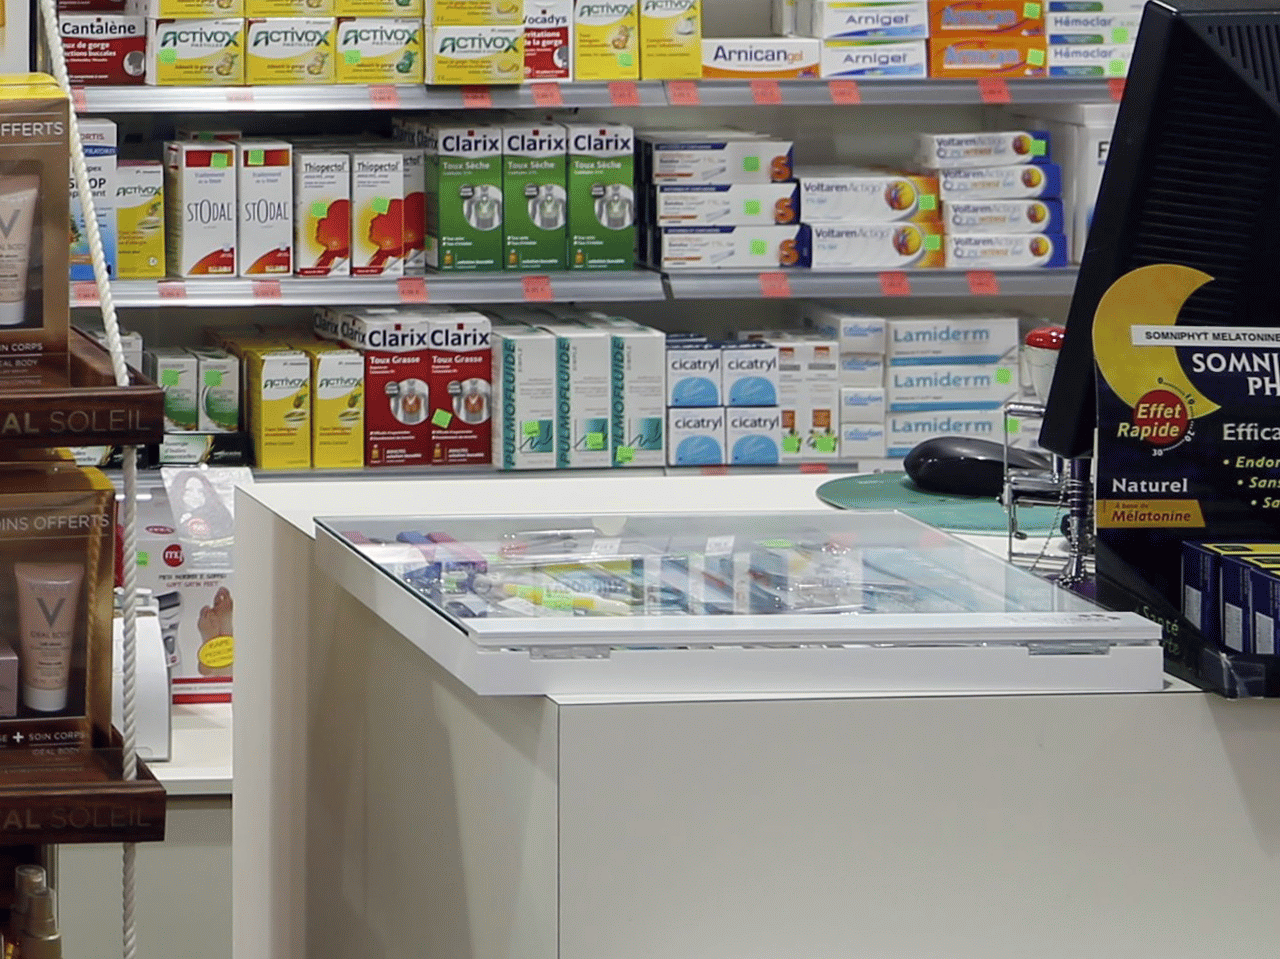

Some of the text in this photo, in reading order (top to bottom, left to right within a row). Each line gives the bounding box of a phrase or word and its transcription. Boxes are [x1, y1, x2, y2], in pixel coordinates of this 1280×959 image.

[62, 20, 136, 35] Cantalène
[846, 13, 910, 28] Arnigel
[442, 134, 499, 152] Clarix
[574, 134, 631, 152] Clarix
[893, 326, 989, 343] Lamiderm
[1145, 331, 1280, 342] SOMNIPHYT MELATONINE
[370, 355, 420, 364] Toux Grasse
[671, 356, 720, 373] cicatryl
[728, 356, 776, 373] cicatryl
[505, 338, 516, 468] PULMOFLUIDE
[1136, 404, 1182, 419] Effet
[49, 410, 151, 433] SOLEIL
[1118, 422, 1179, 441] Rapide
[1112, 478, 1188, 492] Naturel
[1112, 510, 1191, 522] Mélatonine
